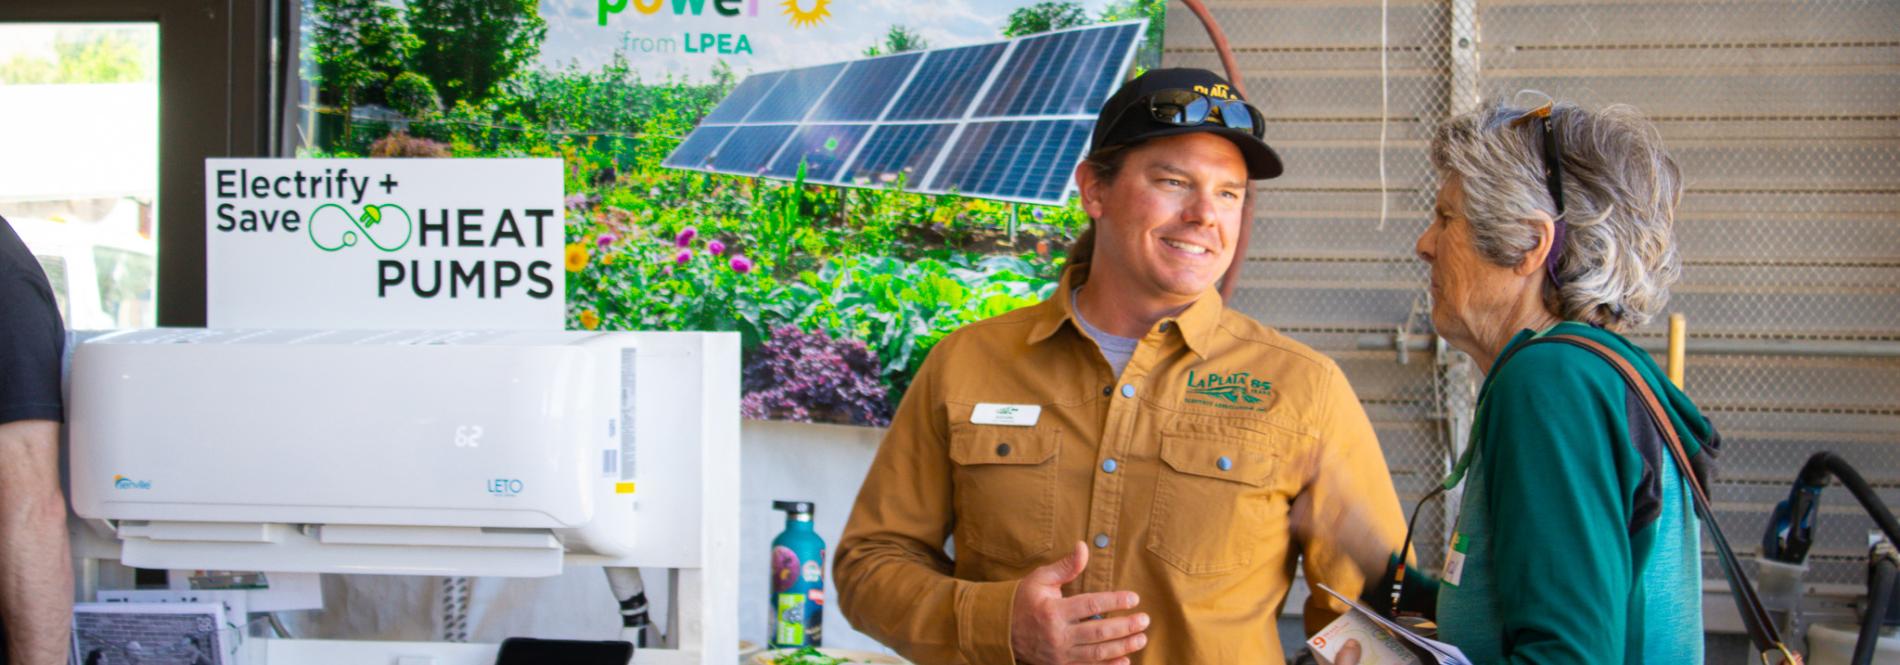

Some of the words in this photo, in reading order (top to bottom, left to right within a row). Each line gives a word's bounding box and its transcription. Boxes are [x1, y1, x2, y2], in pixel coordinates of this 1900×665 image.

[622, 31, 676, 52] from
[684, 33, 753, 54] LPEA
[216, 168, 370, 205] Electrify
[379, 174, 399, 195] +
[216, 203, 301, 232] Save
[418, 208, 555, 247] HEAT
[377, 259, 555, 299] PUMPS
[455, 425, 483, 448] 62
[487, 478, 524, 493] LETO
